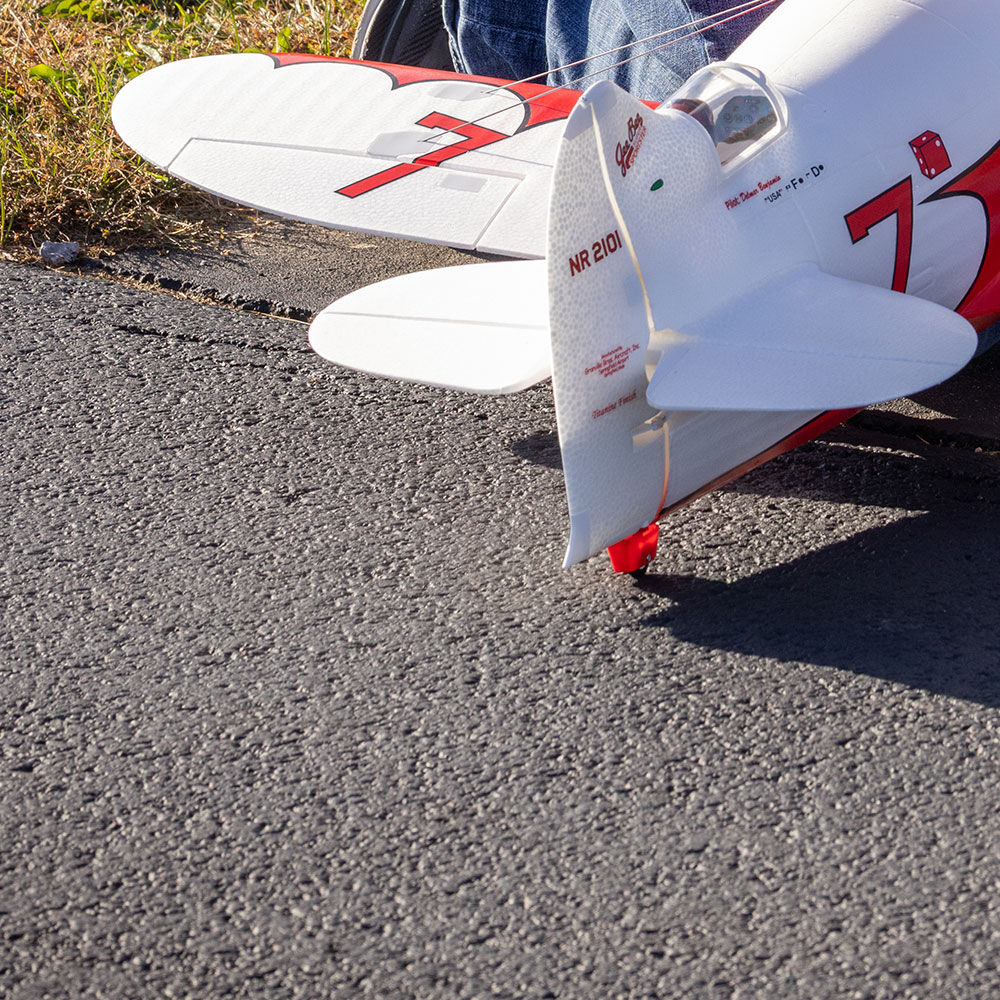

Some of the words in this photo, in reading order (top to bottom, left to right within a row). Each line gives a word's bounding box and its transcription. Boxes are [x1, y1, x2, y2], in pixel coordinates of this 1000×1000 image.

[334, 111, 513, 199] 7
[568, 249, 592, 277] NR
[591, 229, 623, 263] 2101
[844, 175, 913, 294] 7
